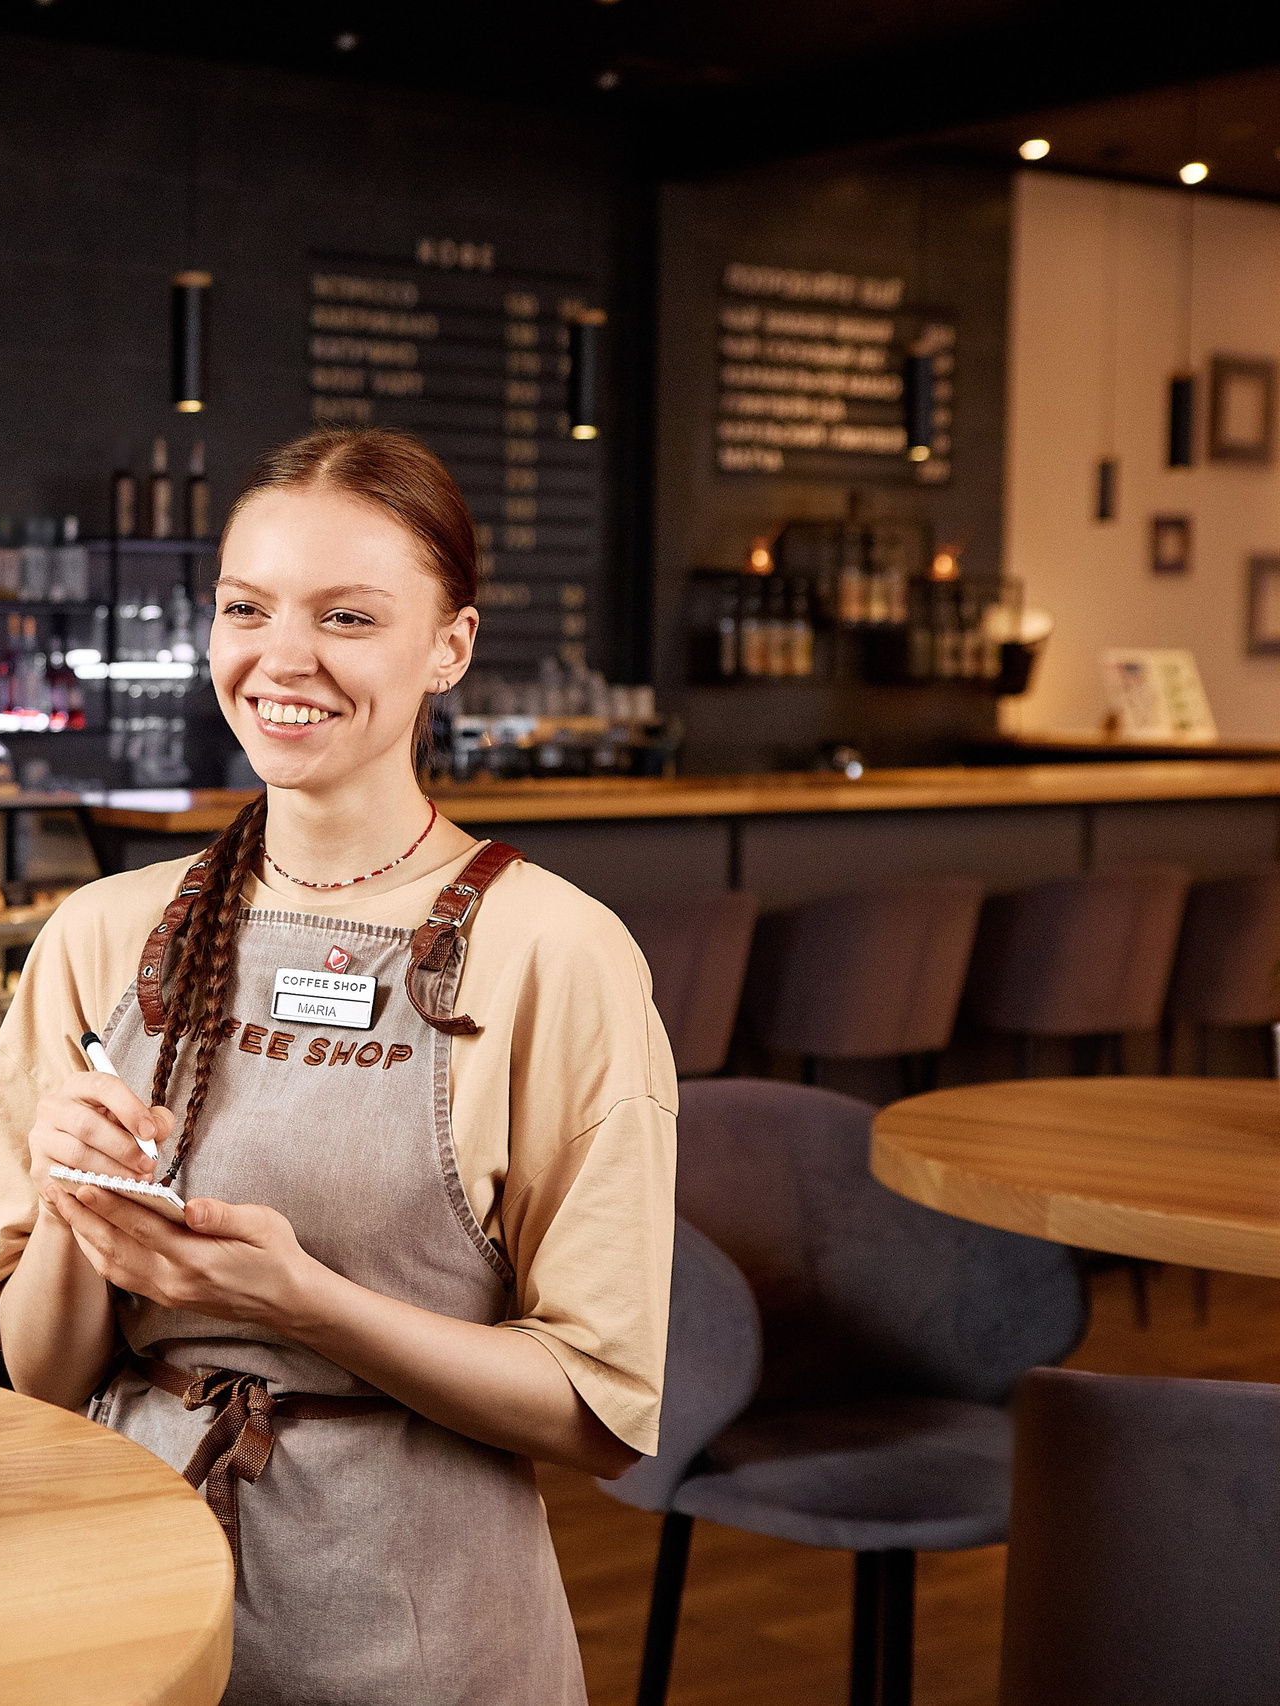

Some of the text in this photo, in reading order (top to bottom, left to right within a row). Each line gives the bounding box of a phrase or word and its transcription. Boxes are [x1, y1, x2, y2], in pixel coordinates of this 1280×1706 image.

[282, 975, 368, 993] COFFEE SHOP
[297, 1002, 337, 1018] MARIA
[303, 1036, 413, 1071] SHOP
